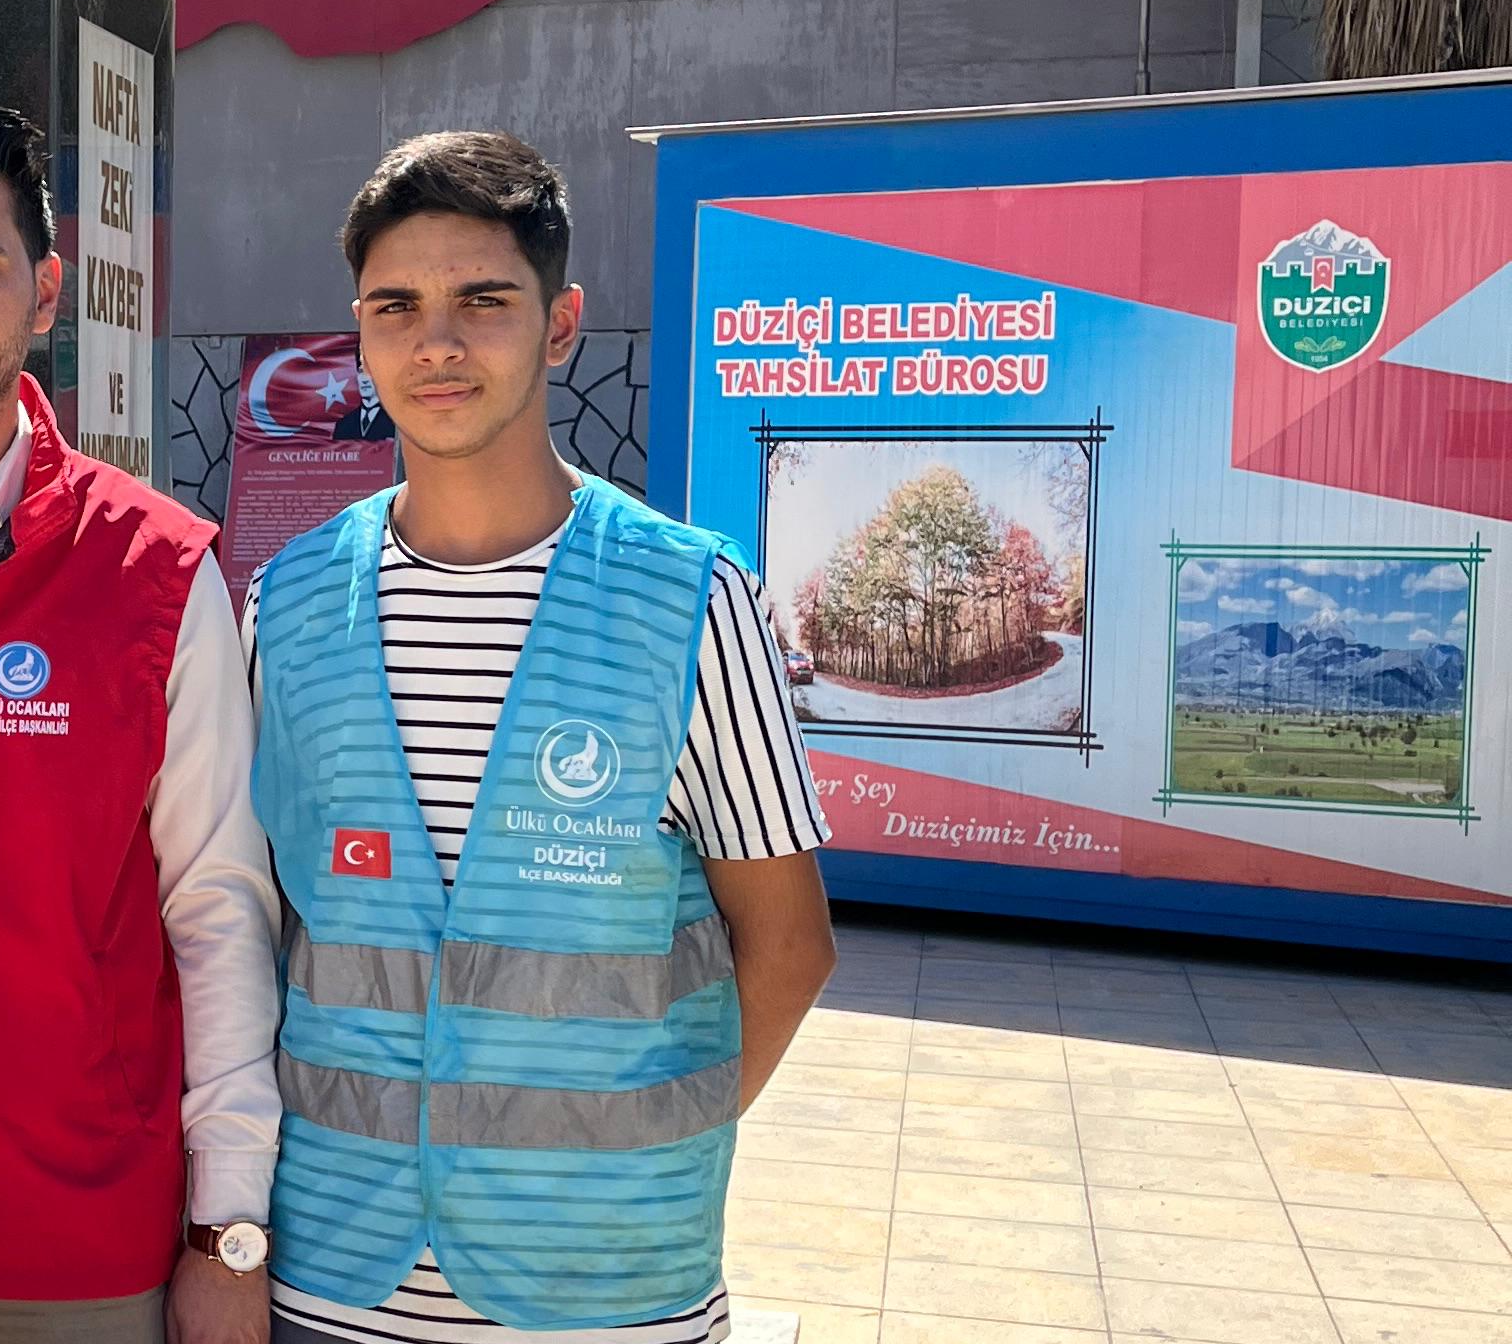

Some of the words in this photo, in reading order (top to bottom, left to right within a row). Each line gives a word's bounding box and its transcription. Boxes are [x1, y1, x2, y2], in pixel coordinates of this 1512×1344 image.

[92, 60, 141, 147] NAFTA
[86, 253, 144, 332] KAYBET
[714, 296, 833, 351] DÜZİÇİ
[839, 291, 1055, 342] BELEDİYESİ
[108, 371, 124, 415] VE
[716, 352, 887, 397] TAHSİLAT
[892, 350, 1048, 395] BÜROSU
[7, 700, 70, 717] OCAKLARI
[813, 770, 843, 796] er
[850, 773, 896, 807] Şey
[506, 805, 547, 832] Ülkü
[882, 811, 1027, 847] Düziçimiz
[1033, 816, 1121, 854] İçin...
[533, 843, 606, 873] DÜZİÇİ
[543, 870, 623, 886] BAŞKANLIĞI
